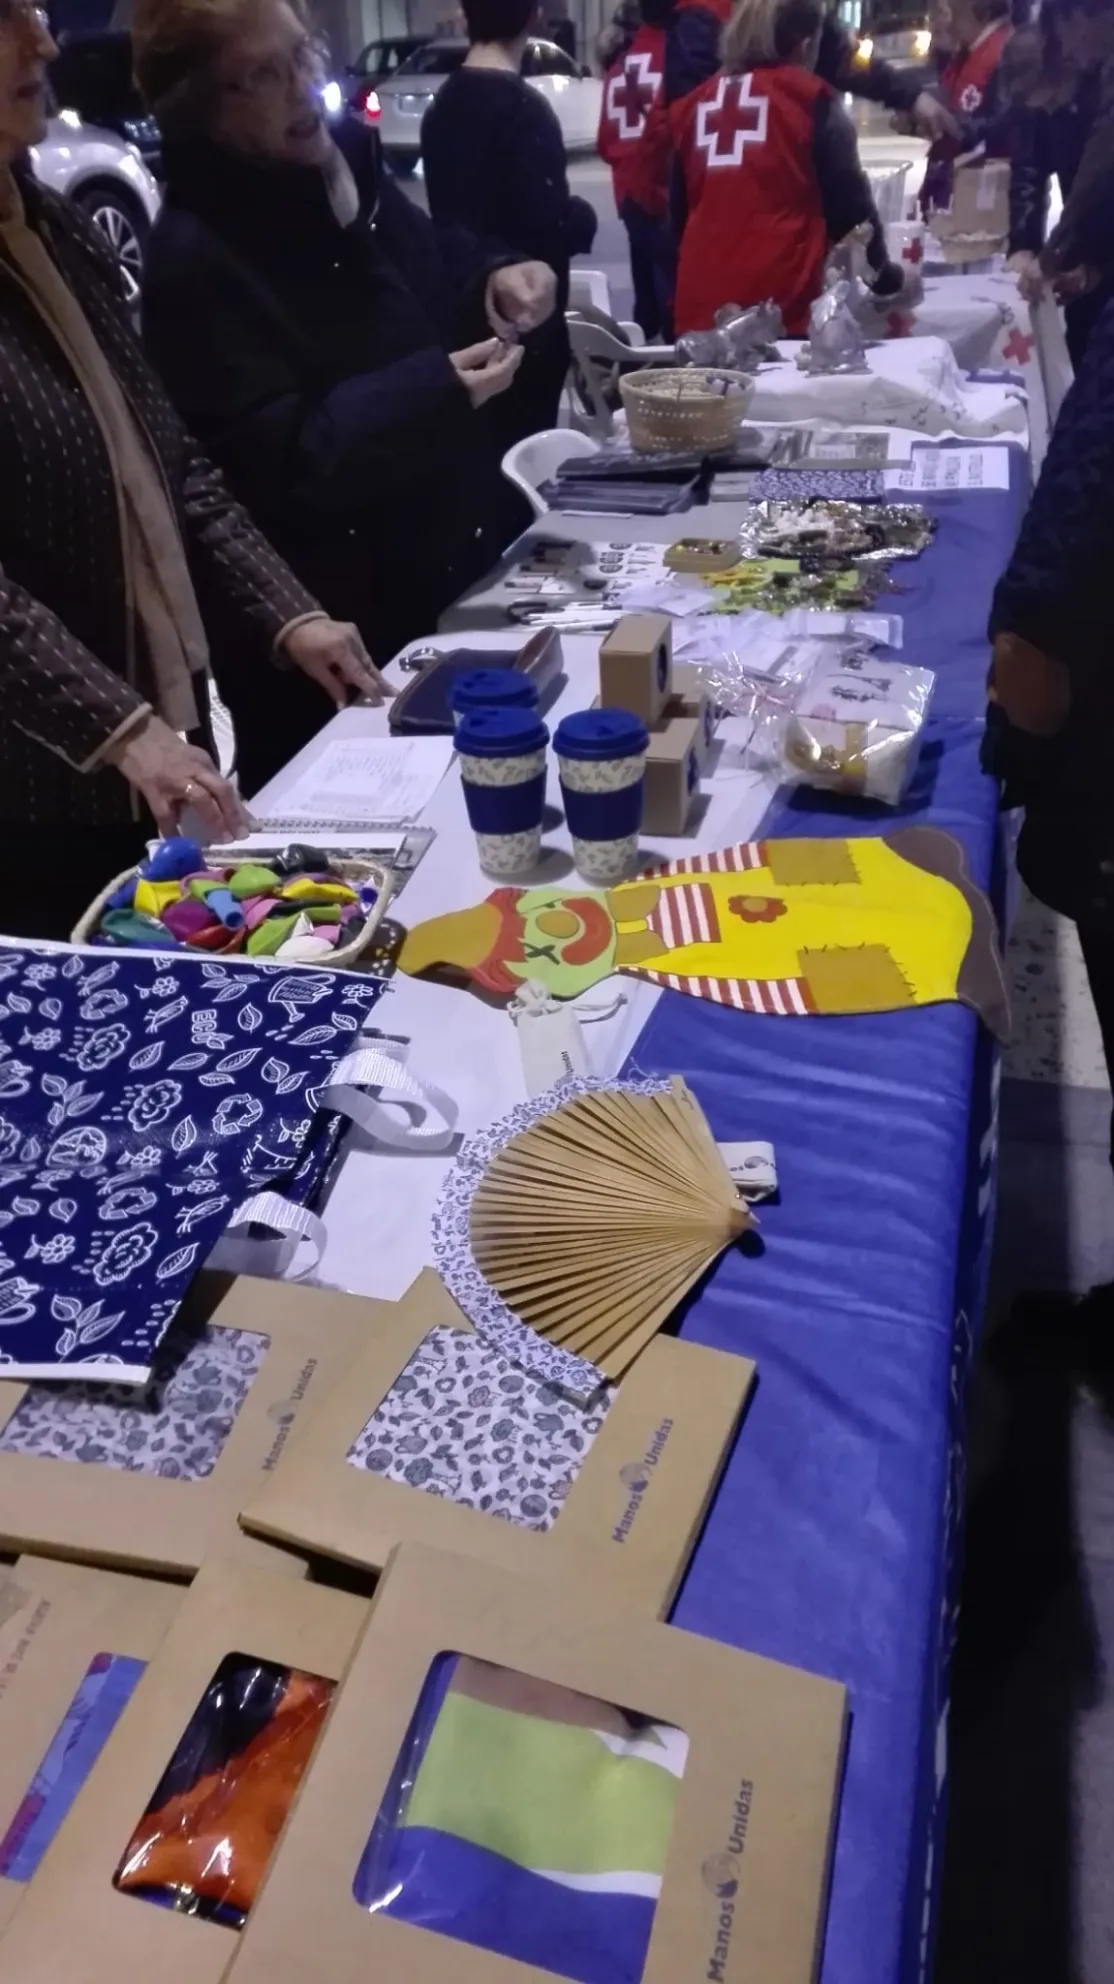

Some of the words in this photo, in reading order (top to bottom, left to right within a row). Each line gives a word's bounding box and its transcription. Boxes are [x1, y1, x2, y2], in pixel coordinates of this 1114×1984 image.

[191, 1008, 219, 1046] ECO
[261, 1424, 291, 1471] Manos
[290, 1358, 318, 1401] Unidas
[611, 1492, 643, 1543] Manos
[643, 1417, 674, 1466] Unidas
[706, 1900, 736, 1983] Manos
[727, 1778, 754, 1855] Unidas
